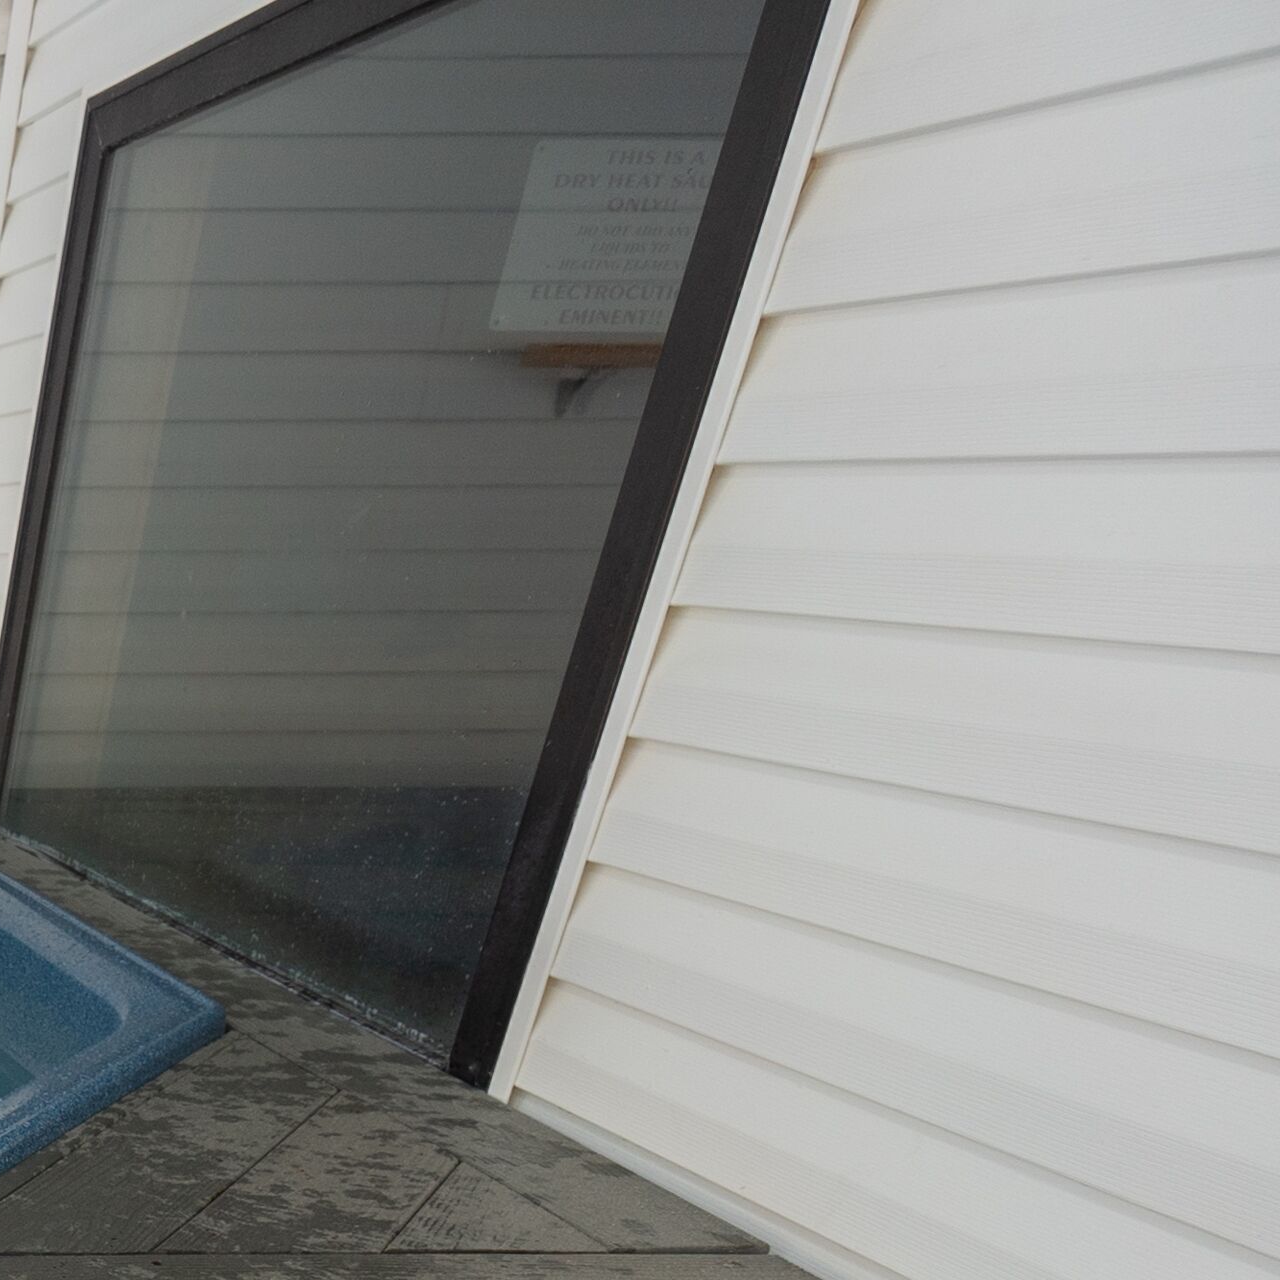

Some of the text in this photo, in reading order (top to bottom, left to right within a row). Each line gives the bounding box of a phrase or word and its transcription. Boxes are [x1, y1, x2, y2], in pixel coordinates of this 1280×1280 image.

[607, 150, 705, 165] THIS IS A
[553, 173, 602, 189] DRY
[607, 173, 666, 189] HEAT
